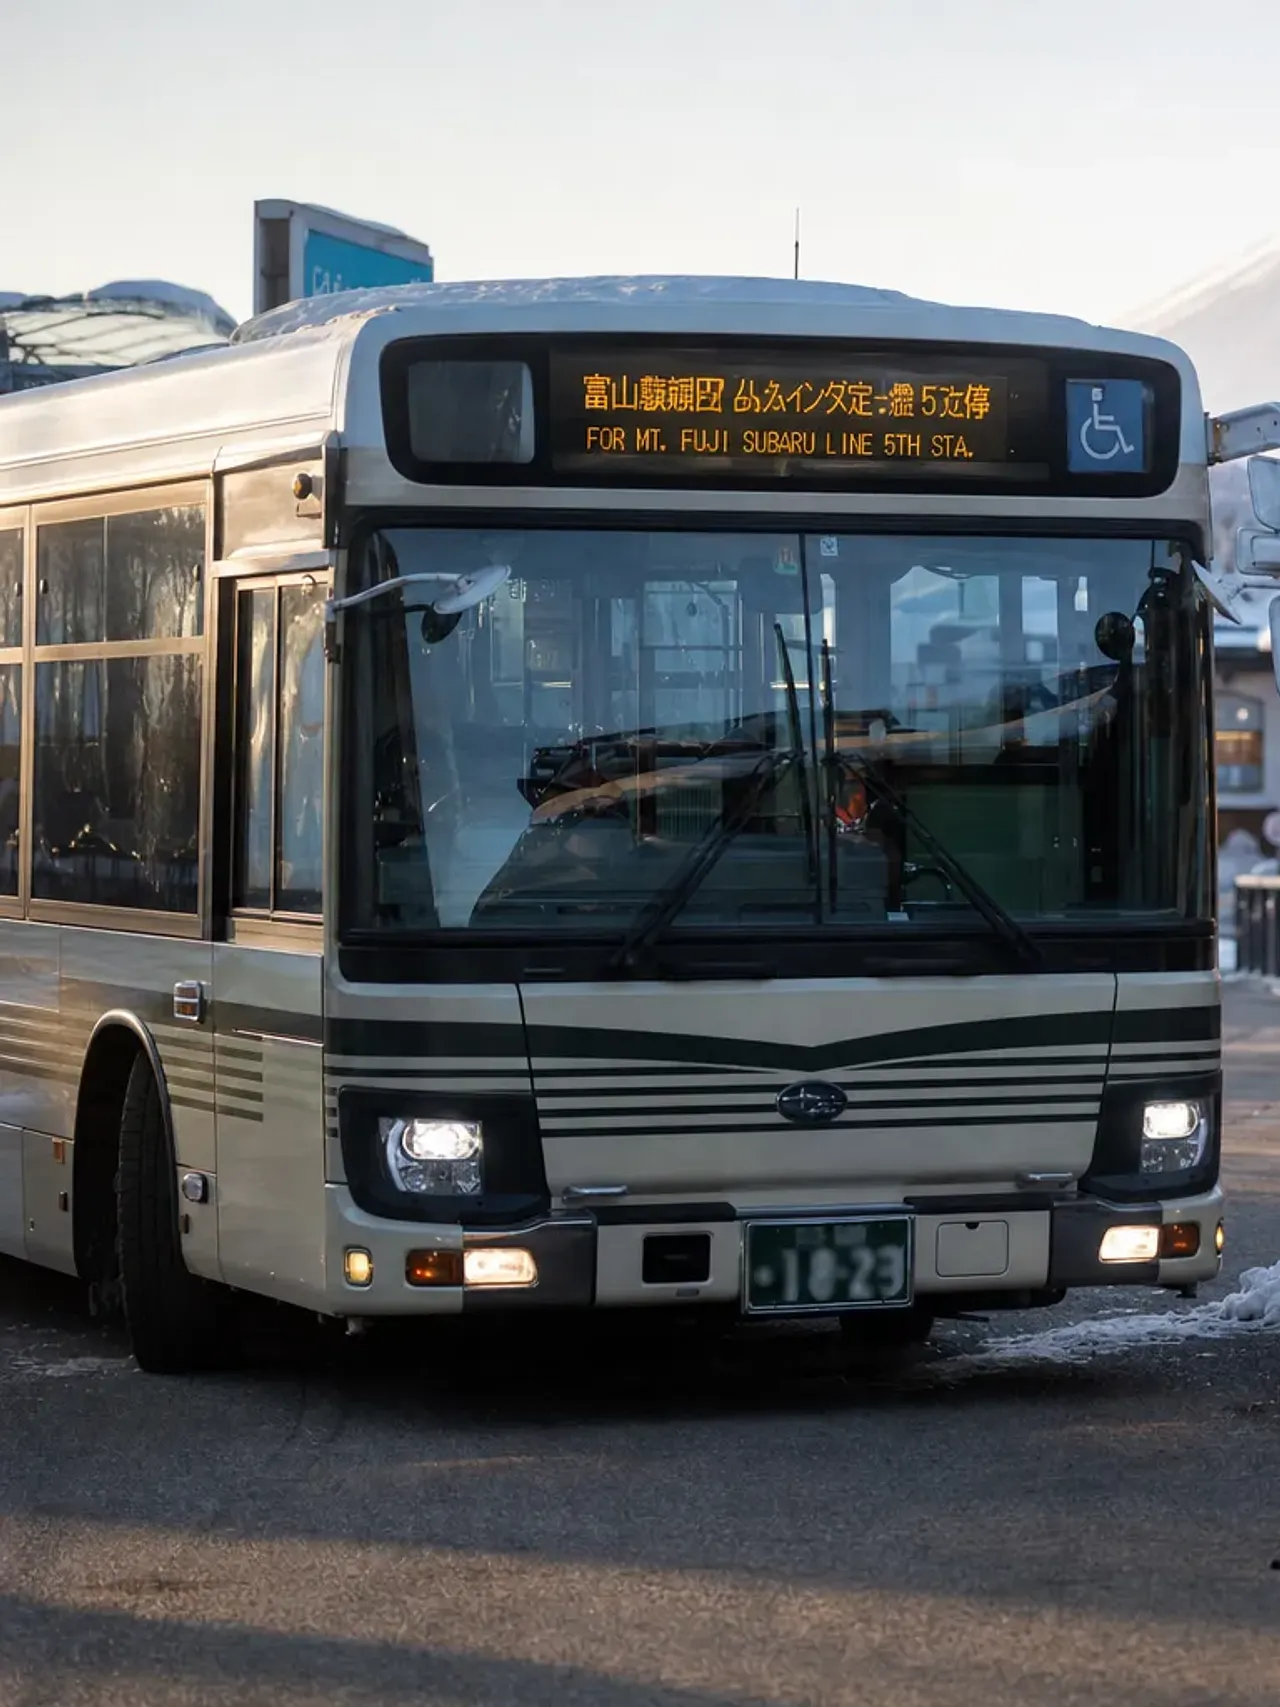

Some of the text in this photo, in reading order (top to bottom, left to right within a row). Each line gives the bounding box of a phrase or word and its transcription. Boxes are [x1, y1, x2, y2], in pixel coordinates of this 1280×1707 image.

[586, 426, 973, 458] FOR MT. FUJI SUBARU LINE 5TH STA.
